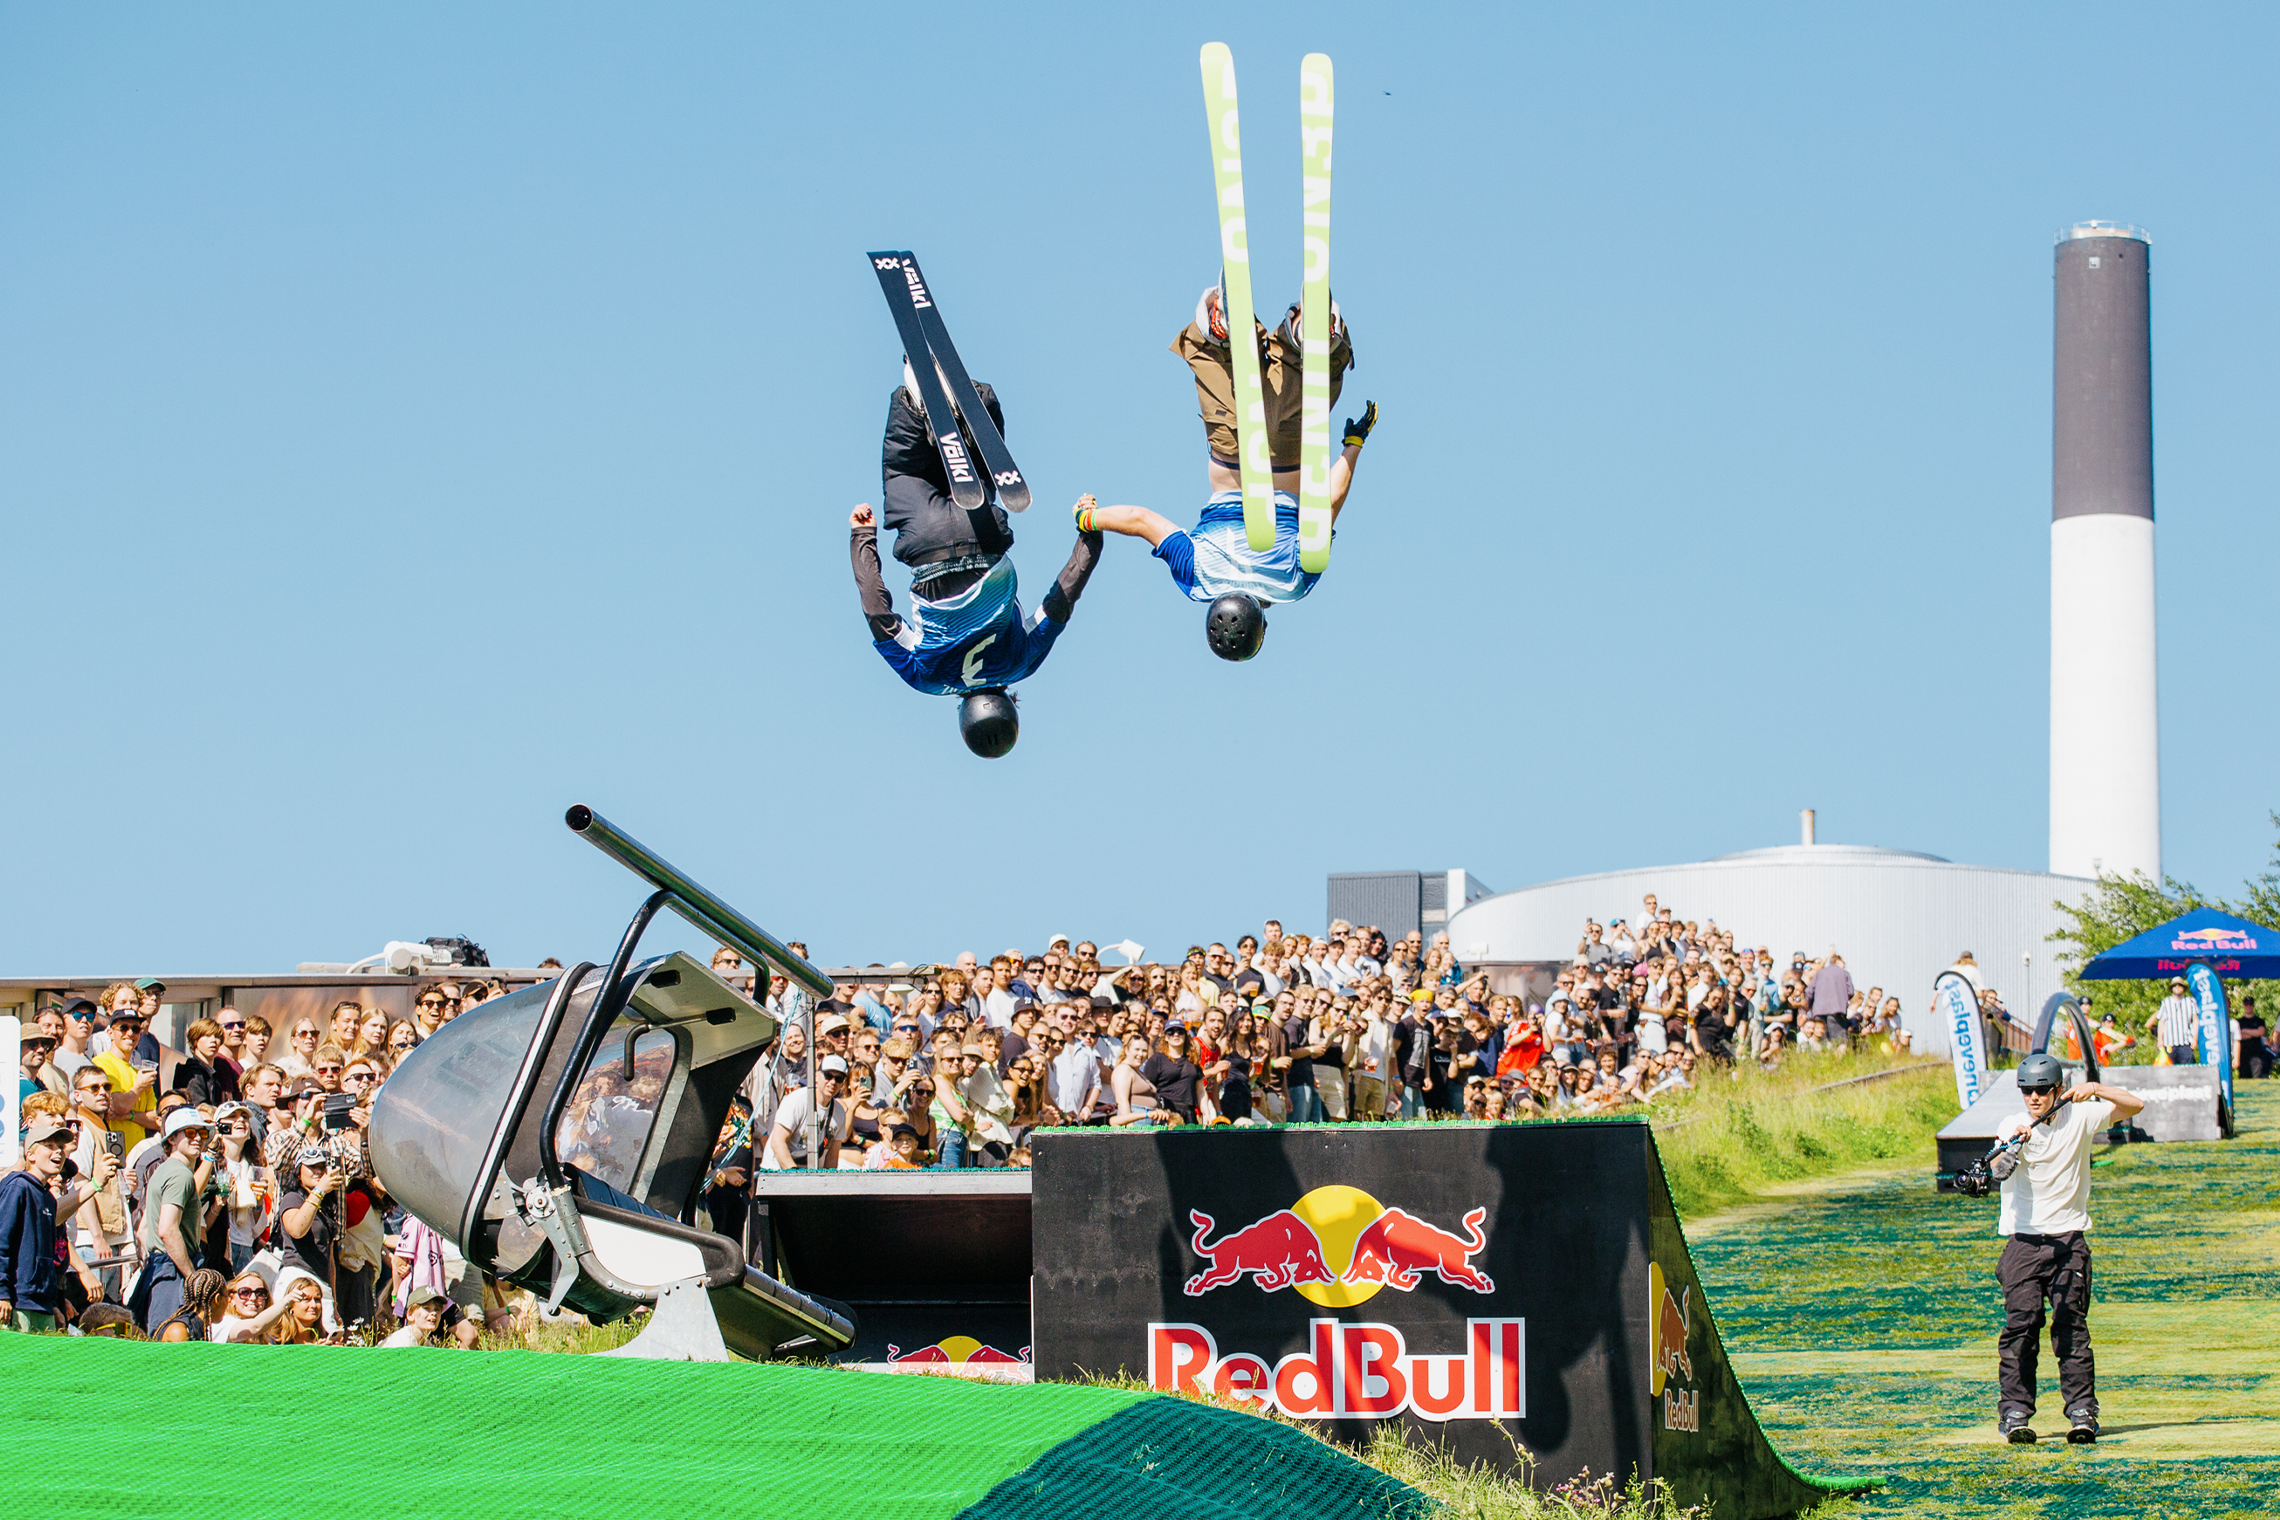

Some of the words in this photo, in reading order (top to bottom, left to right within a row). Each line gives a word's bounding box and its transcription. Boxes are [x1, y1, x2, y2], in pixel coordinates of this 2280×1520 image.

[940, 431, 974, 483] Völkl
[2171, 940, 2214, 951] Red
[2215, 938, 2257, 950] Bull
